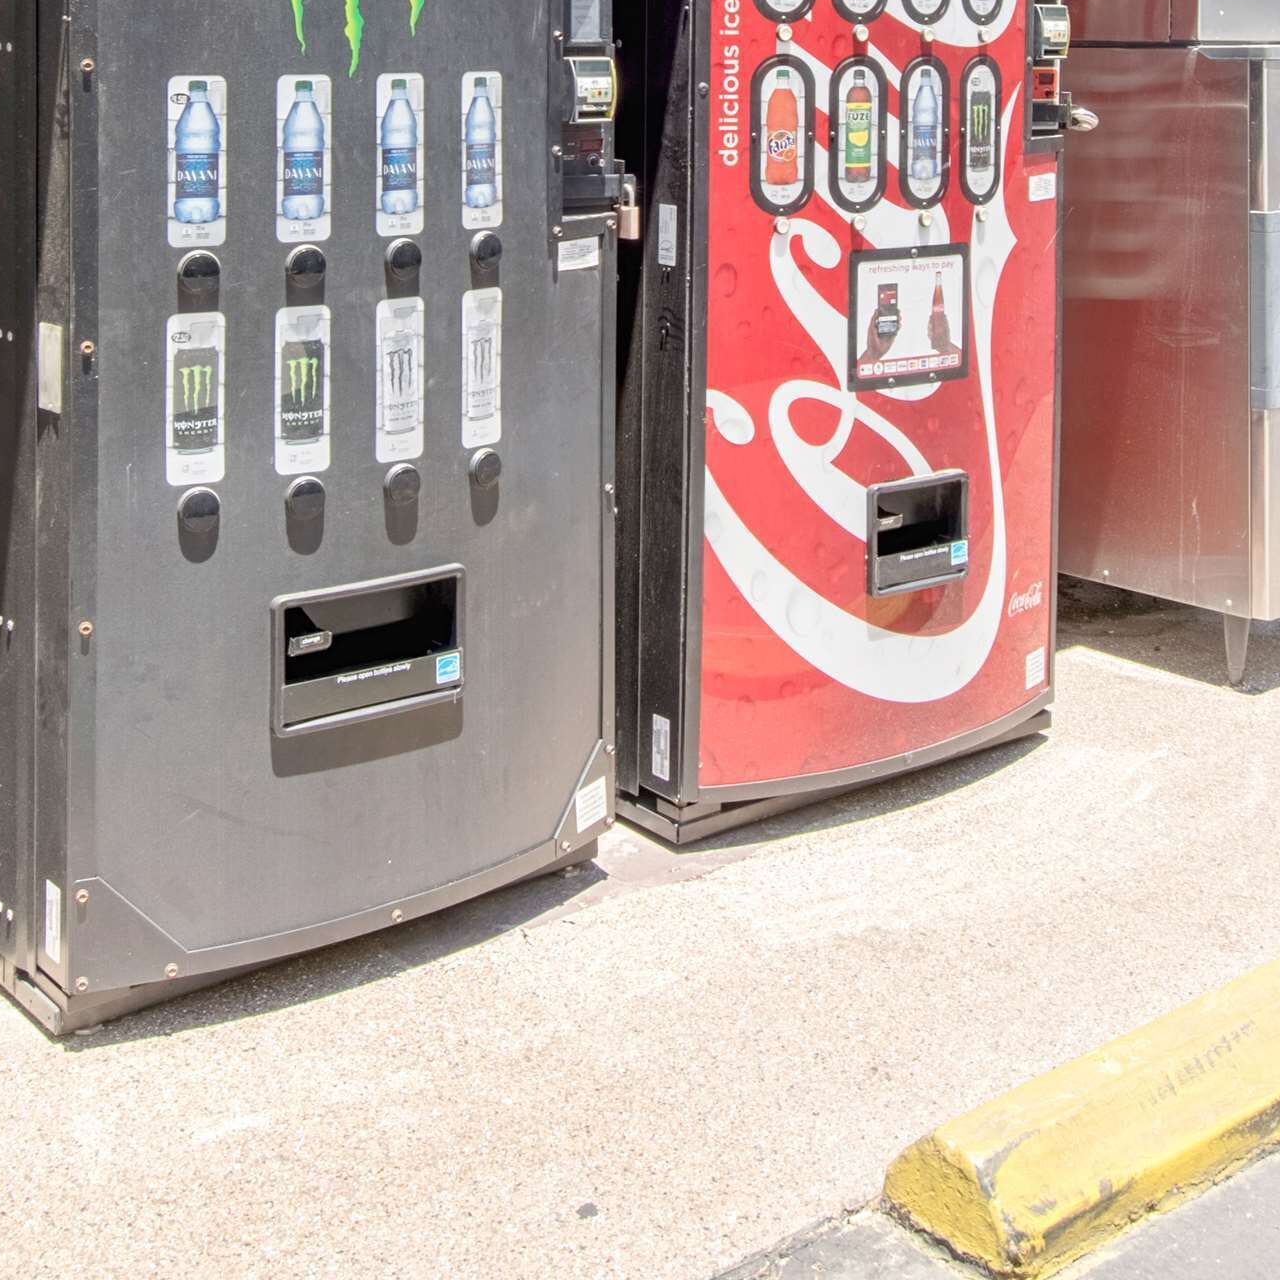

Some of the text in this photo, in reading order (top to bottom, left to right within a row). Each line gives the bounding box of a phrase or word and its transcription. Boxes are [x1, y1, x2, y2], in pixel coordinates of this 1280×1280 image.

[718, 43, 740, 167] delicious
[868, 263, 910, 274] refreshing
[336, 673, 358, 684] Please
[358, 670, 373, 680] open
